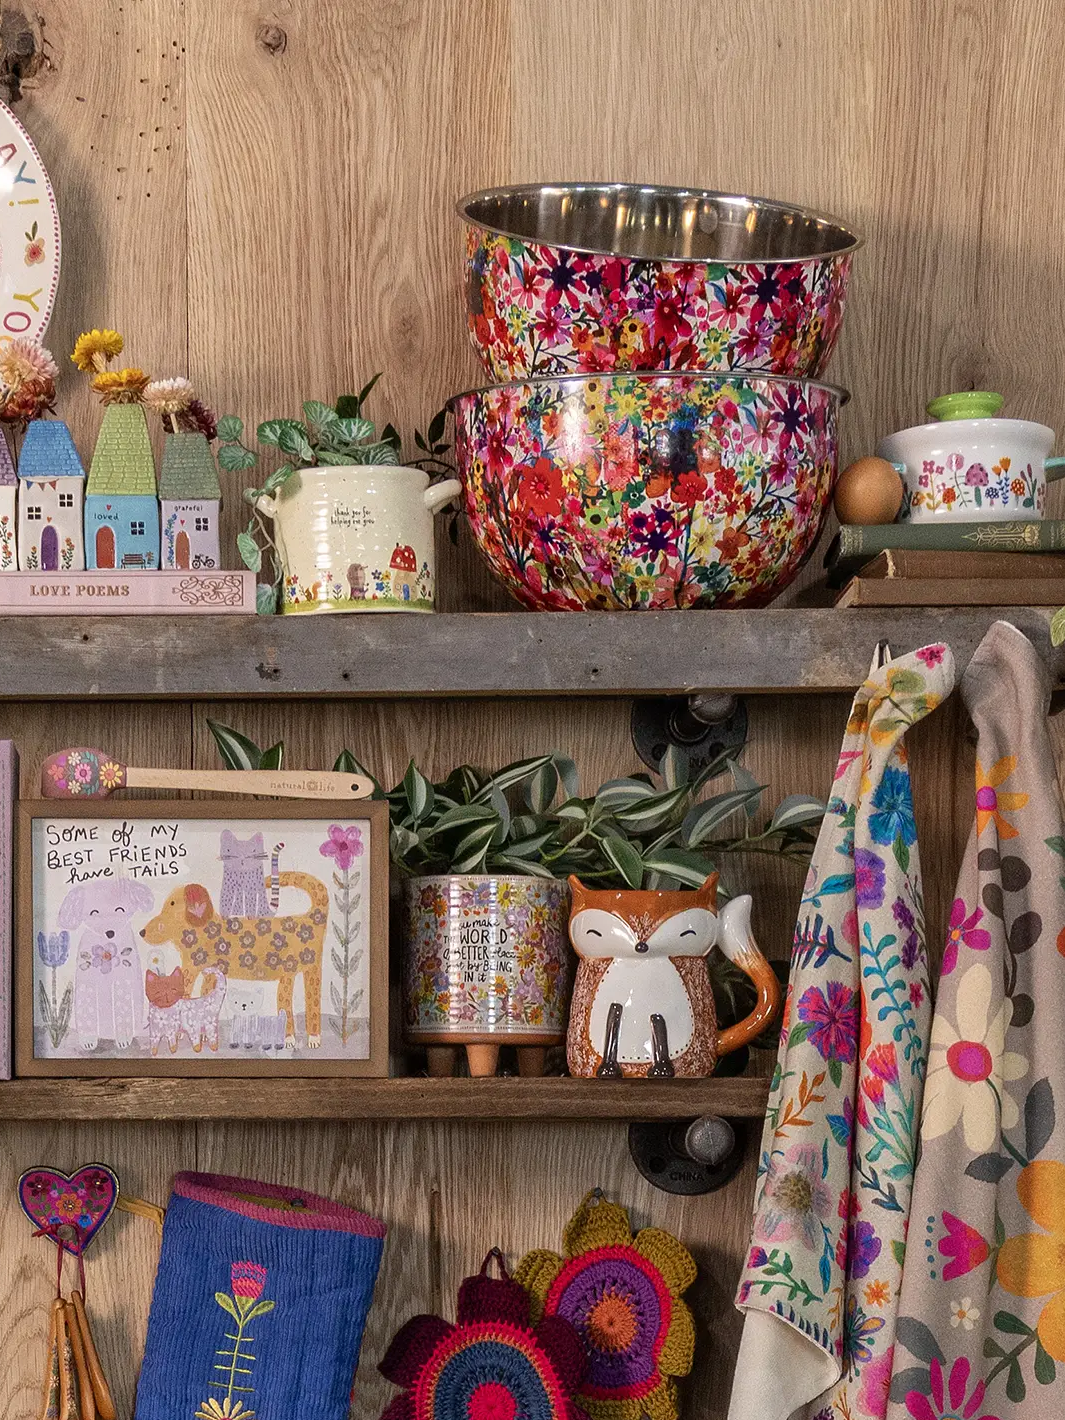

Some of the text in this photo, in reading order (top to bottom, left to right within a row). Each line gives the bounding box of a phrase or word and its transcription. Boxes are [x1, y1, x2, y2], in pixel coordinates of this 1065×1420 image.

[173, 504, 203, 512] grateful
[94, 512, 120, 521] loved
[29, 584, 131, 598] LOVE POEMS
[270, 780, 306, 790] natural
[46, 821, 180, 848] SOME of MY
[46, 849, 94, 870] BEST
[66, 866, 114, 885] have
[459, 928, 508, 945] WORD
